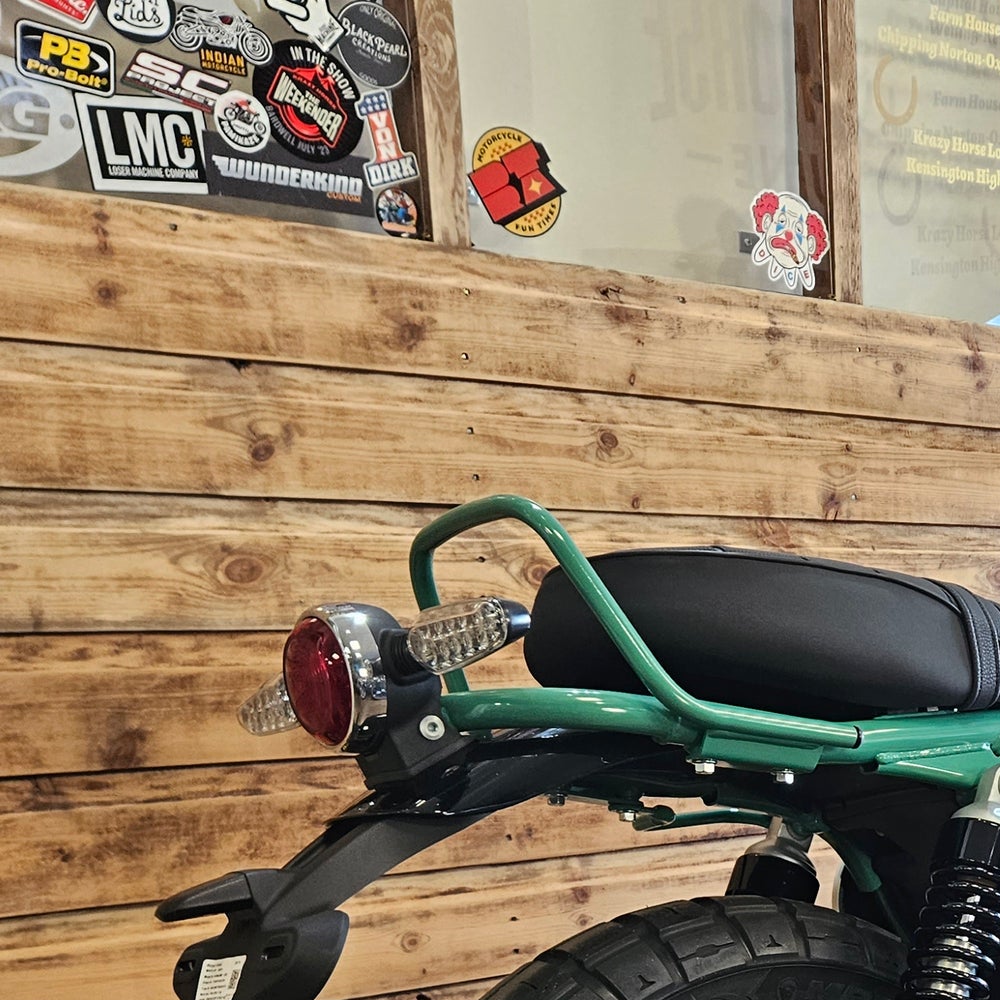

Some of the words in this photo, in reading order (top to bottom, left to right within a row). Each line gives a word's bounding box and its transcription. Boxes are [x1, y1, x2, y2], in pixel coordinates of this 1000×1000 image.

[928, 4, 963, 28] Farm
[964, 12, 1000, 36] House
[40, 31, 91, 70] PB
[342, 17, 375, 47] BLACK
[374, 36, 408, 57] PEARL
[351, 36, 391, 62] CREATIONS
[877, 25, 938, 59] Chipping
[27, 58, 104, 88] Pro-Bolt
[200, 48, 245, 67] INDIAN
[201, 61, 246, 75] MOTORCYCLE
[289, 46, 304, 61] IN
[304, 47, 327, 69] THE
[326, 62, 356, 100] SHOW
[130, 51, 230, 100] SC
[273, 71, 343, 141] WEEKENDER
[305, 90, 321, 103] THE
[96, 109, 196, 168] LMC
[265, 105, 296, 146] BARDWELL
[297, 143, 316, 154] JULY
[369, 112, 398, 161] VON
[913, 128, 950, 154] Krazy
[951, 136, 987, 157] Horse
[477, 131, 522, 163] MOTORCYCLE
[108, 165, 131, 177] LOSER
[131, 166, 164, 178] MACHINE
[164, 167, 199, 179] COMPANY
[212, 154, 363, 196] WUNDERKIND
[368, 158, 417, 185] DIRK
[906, 156, 974, 184] Kensington
[326, 192, 362, 203] CUSTOM
[515, 223, 535, 232] FUN
[537, 202, 557, 230] TIMES
